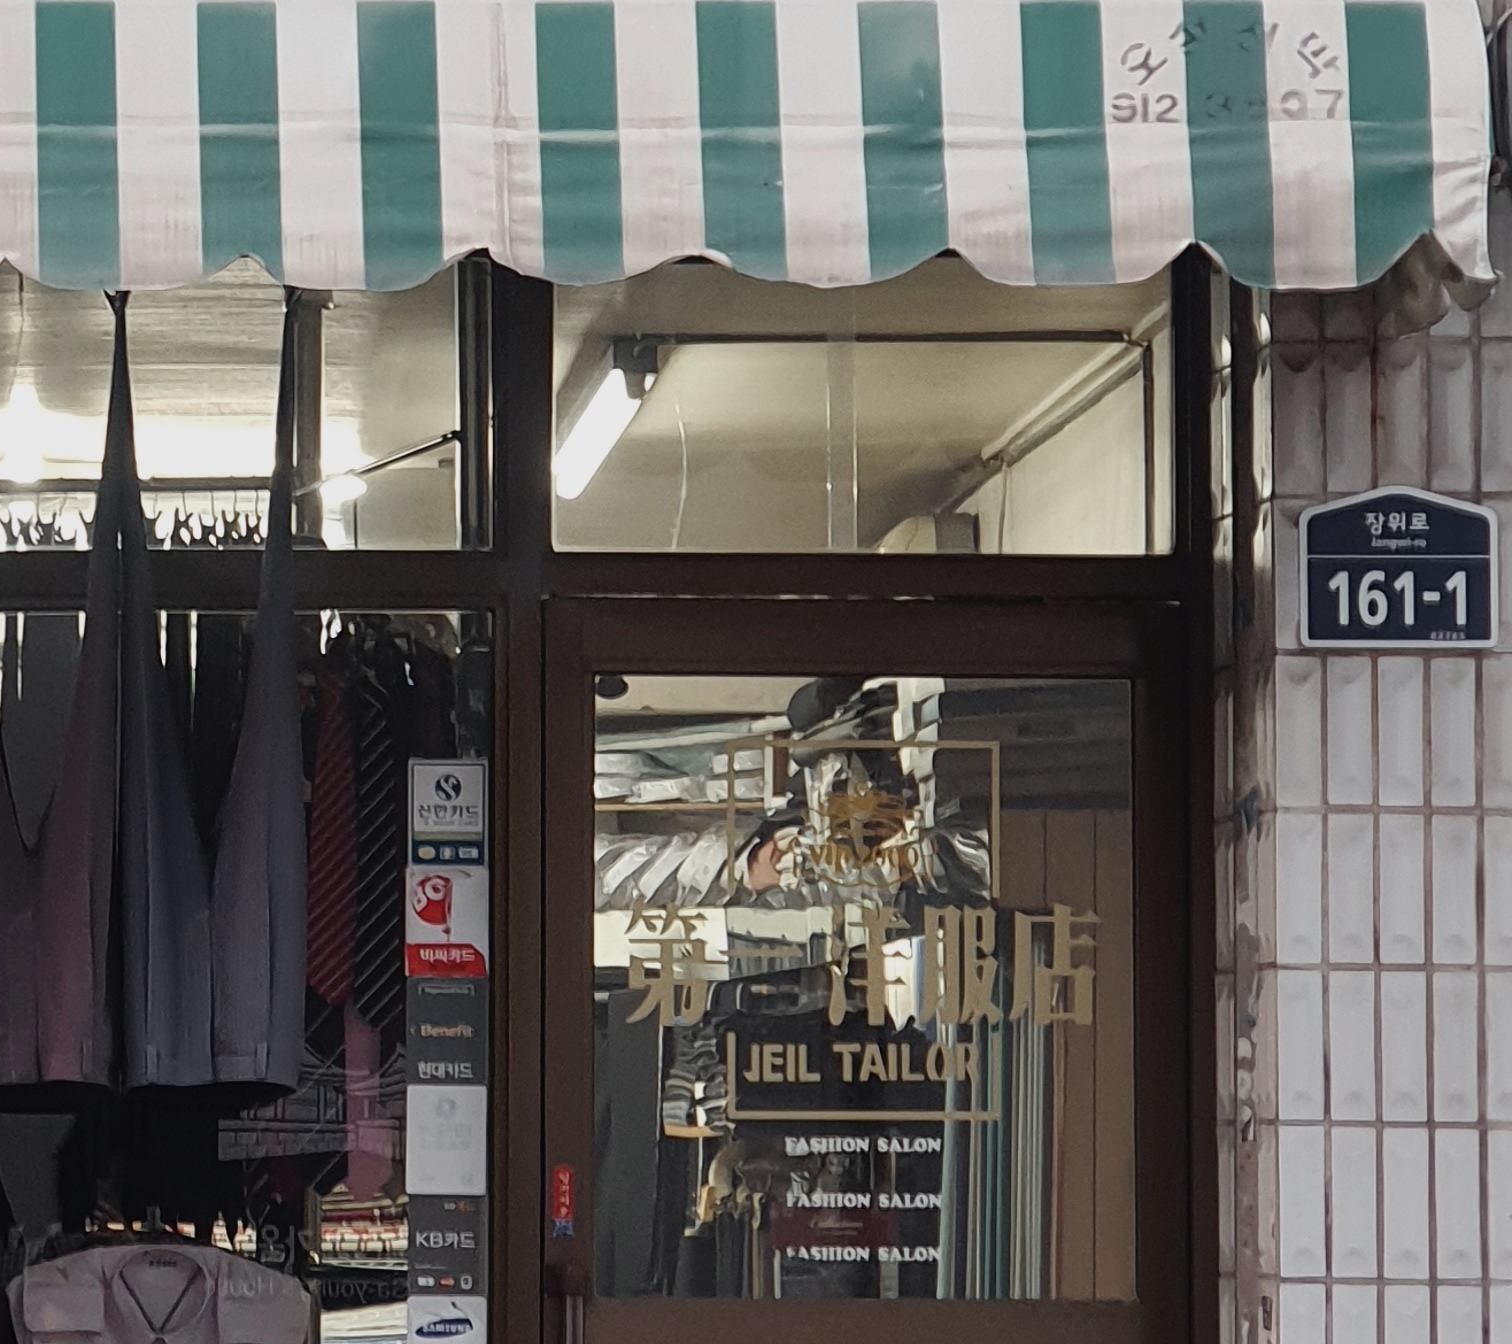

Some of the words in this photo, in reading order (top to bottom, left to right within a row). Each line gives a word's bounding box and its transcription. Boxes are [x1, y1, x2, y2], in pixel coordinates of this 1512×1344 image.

[1364, 511, 1431, 535] 장위로
[1327, 569, 1469, 627] 161-1
[743, 1042, 822, 1084] JEIL
[832, 1042, 980, 1084] TAILOR
[784, 1136, 870, 1154] FASHION
[877, 1136, 942, 1154] SALON
[786, 1192, 872, 1209] FASHION
[878, 1192, 944, 1209] SALON
[415, 1229, 476, 1250] KB카드
[877, 1245, 942, 1262] SALON
